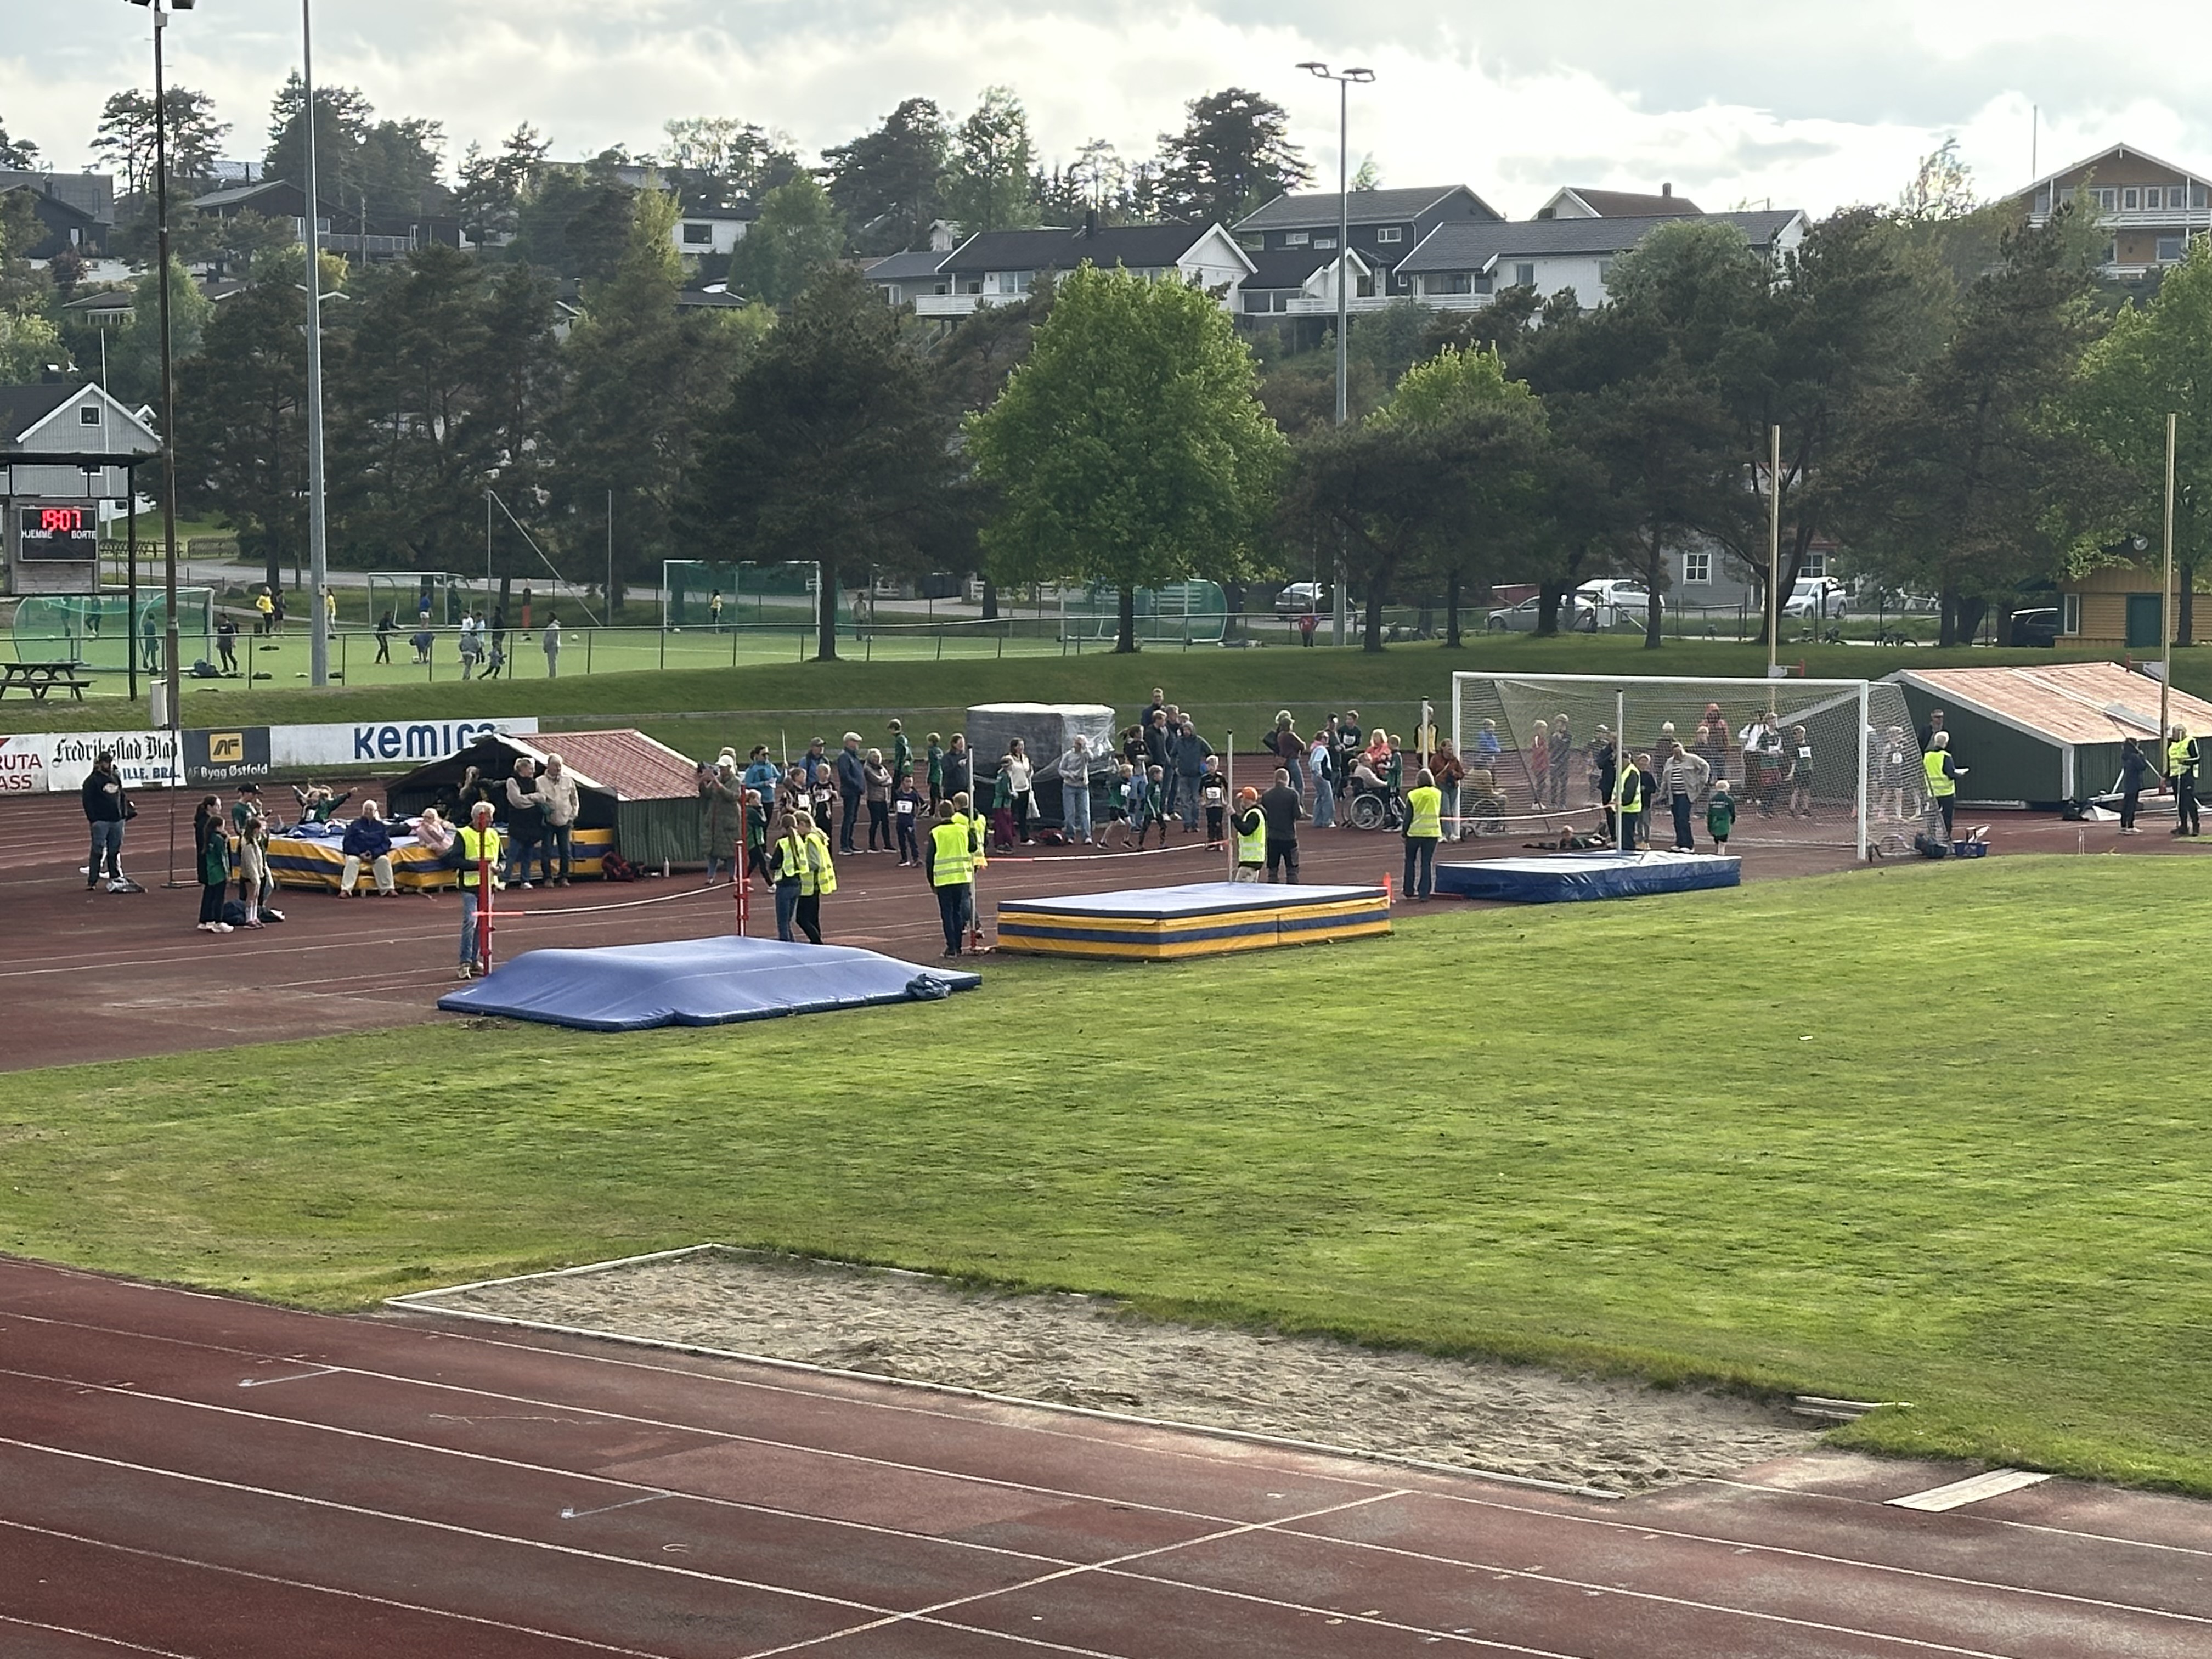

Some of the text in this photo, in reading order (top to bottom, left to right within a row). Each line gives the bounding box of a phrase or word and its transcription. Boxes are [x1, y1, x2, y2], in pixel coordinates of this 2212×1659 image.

[42, 510, 81, 531] 19:07
[213, 739, 239, 755] AF
[200, 766, 227, 781] Bygg
[229, 763, 268, 776] Østfold
